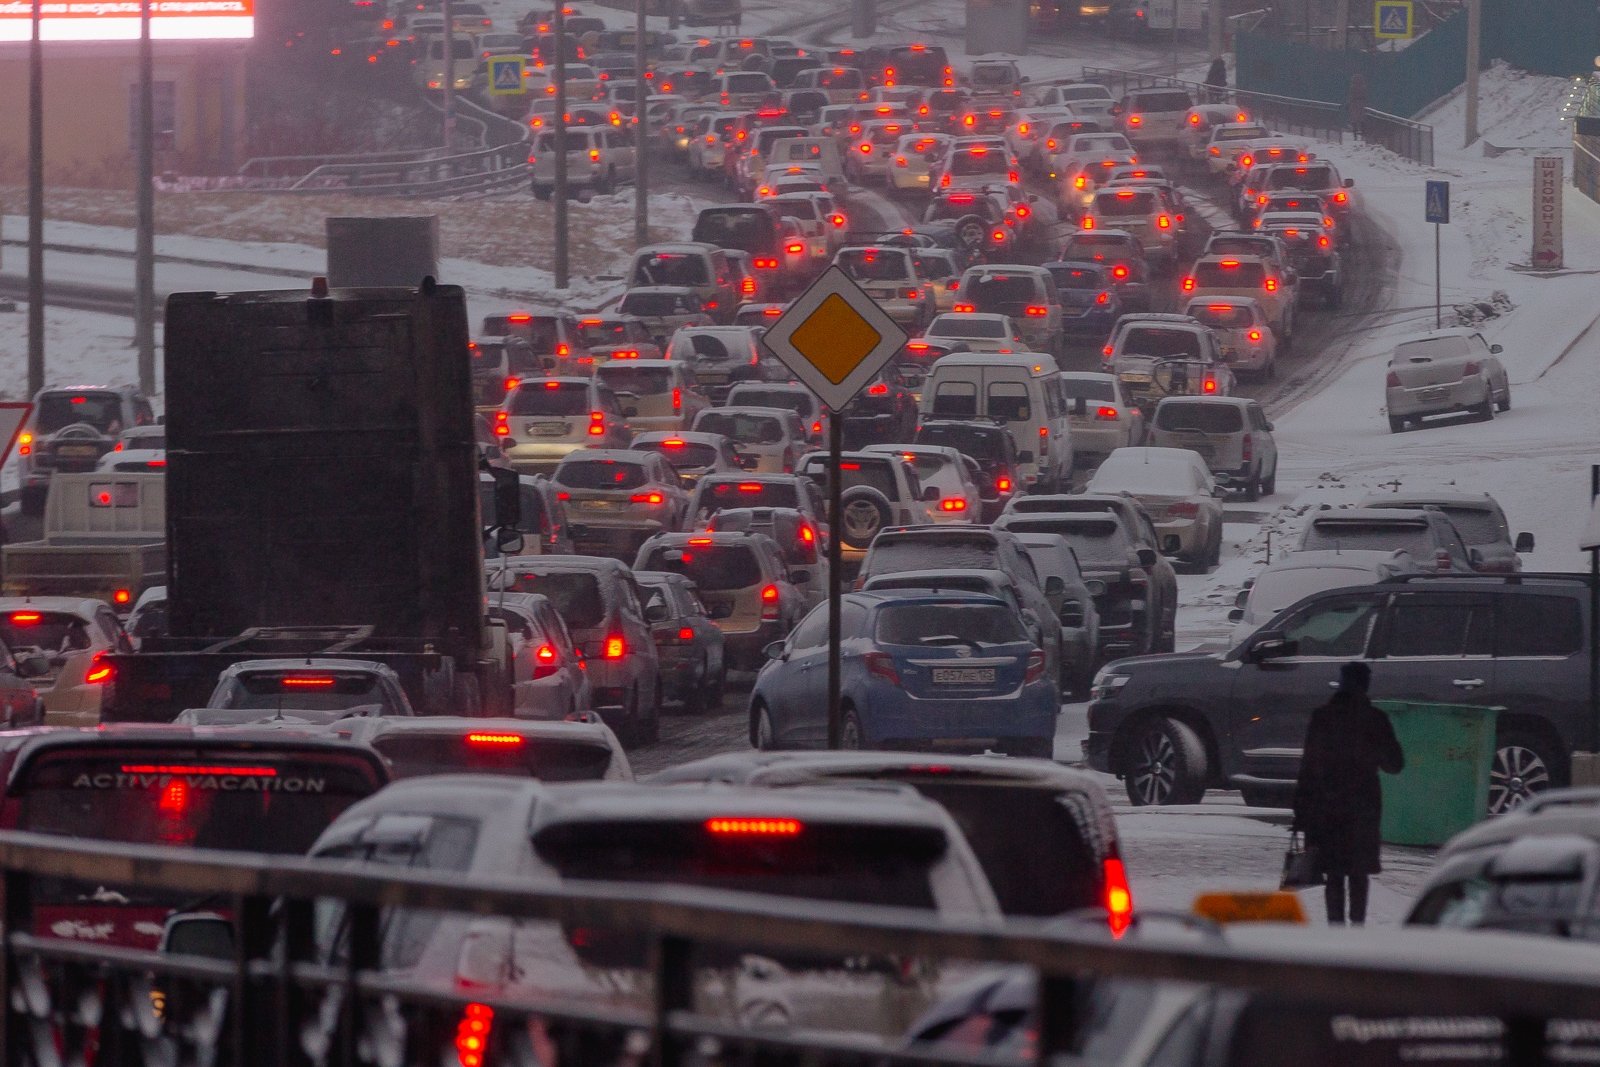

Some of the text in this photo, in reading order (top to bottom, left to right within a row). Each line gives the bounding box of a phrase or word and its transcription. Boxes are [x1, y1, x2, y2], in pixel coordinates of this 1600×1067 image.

[1541, 160, 1555, 246] ШИНОМОНТАЖ
[73, 772, 325, 793] ACTIVE VACATION
